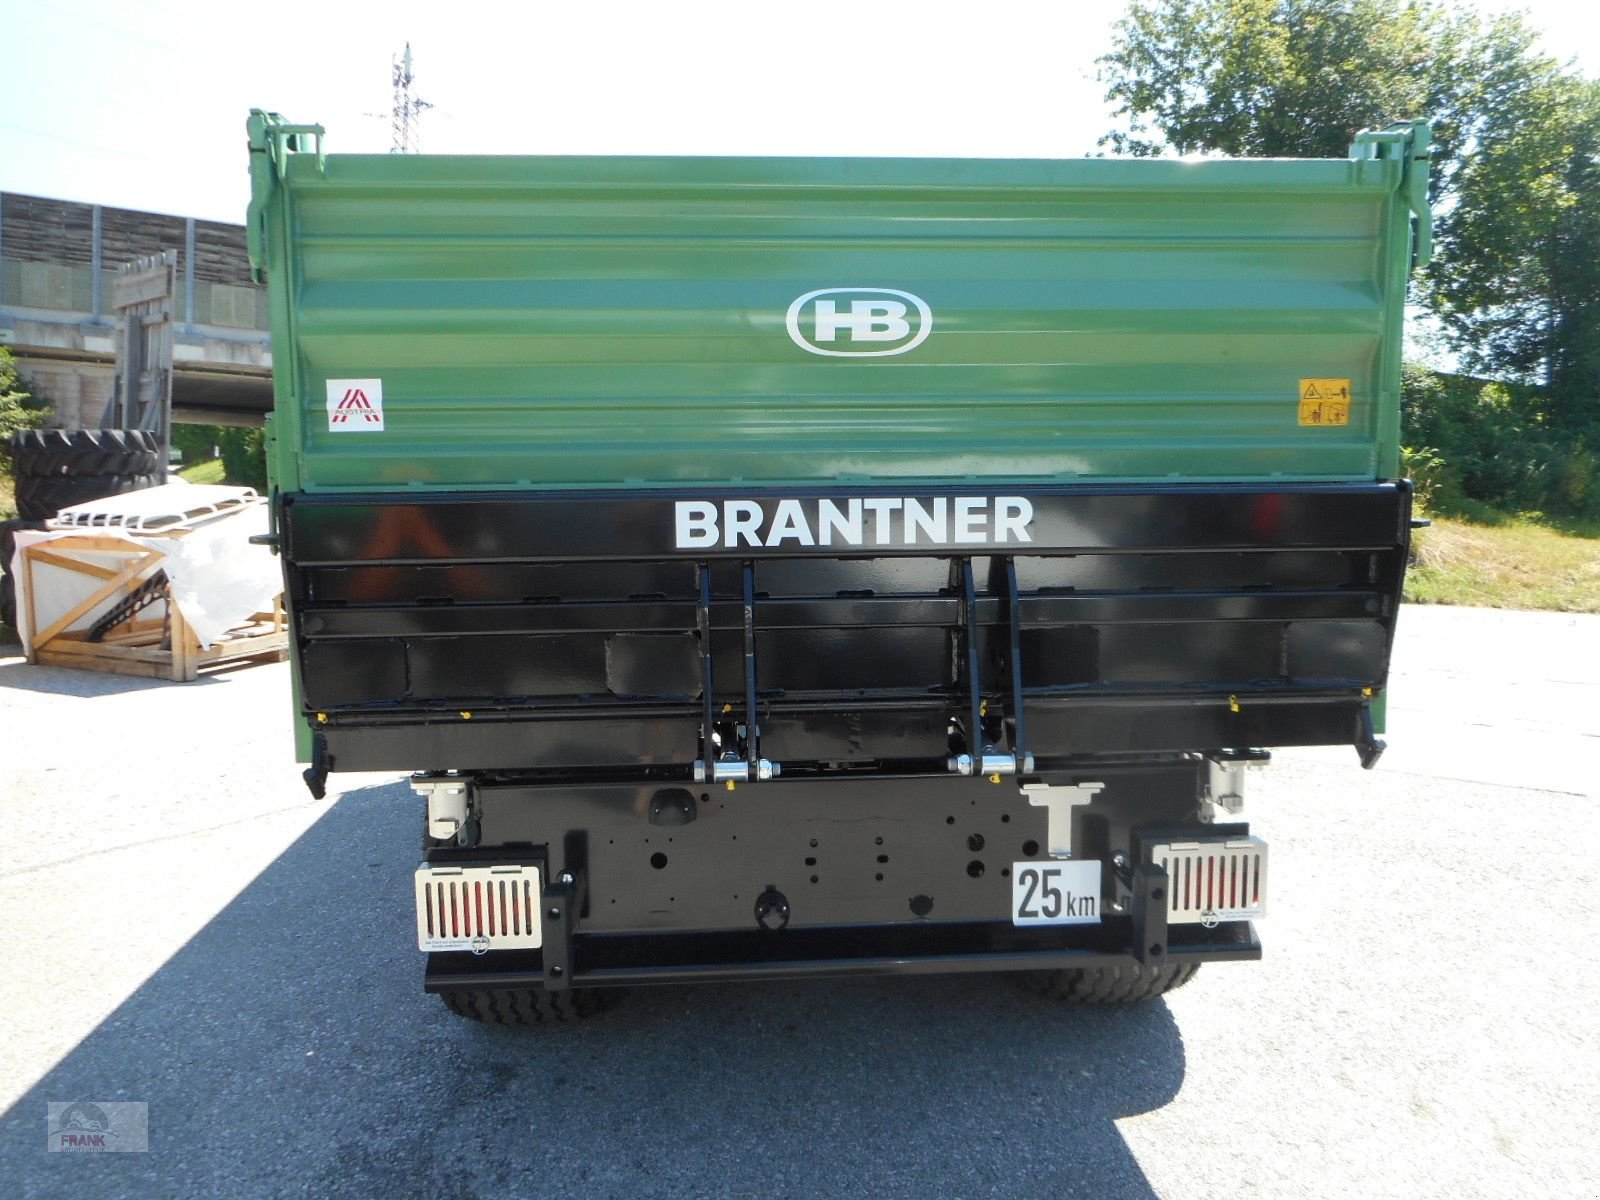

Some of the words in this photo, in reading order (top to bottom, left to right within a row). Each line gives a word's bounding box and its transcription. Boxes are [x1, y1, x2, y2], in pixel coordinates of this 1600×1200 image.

[815, 300, 910, 341] HB
[675, 496, 1034, 548] BRANTNER
[1018, 869, 1061, 918] 25
[1067, 891, 1095, 916] km
